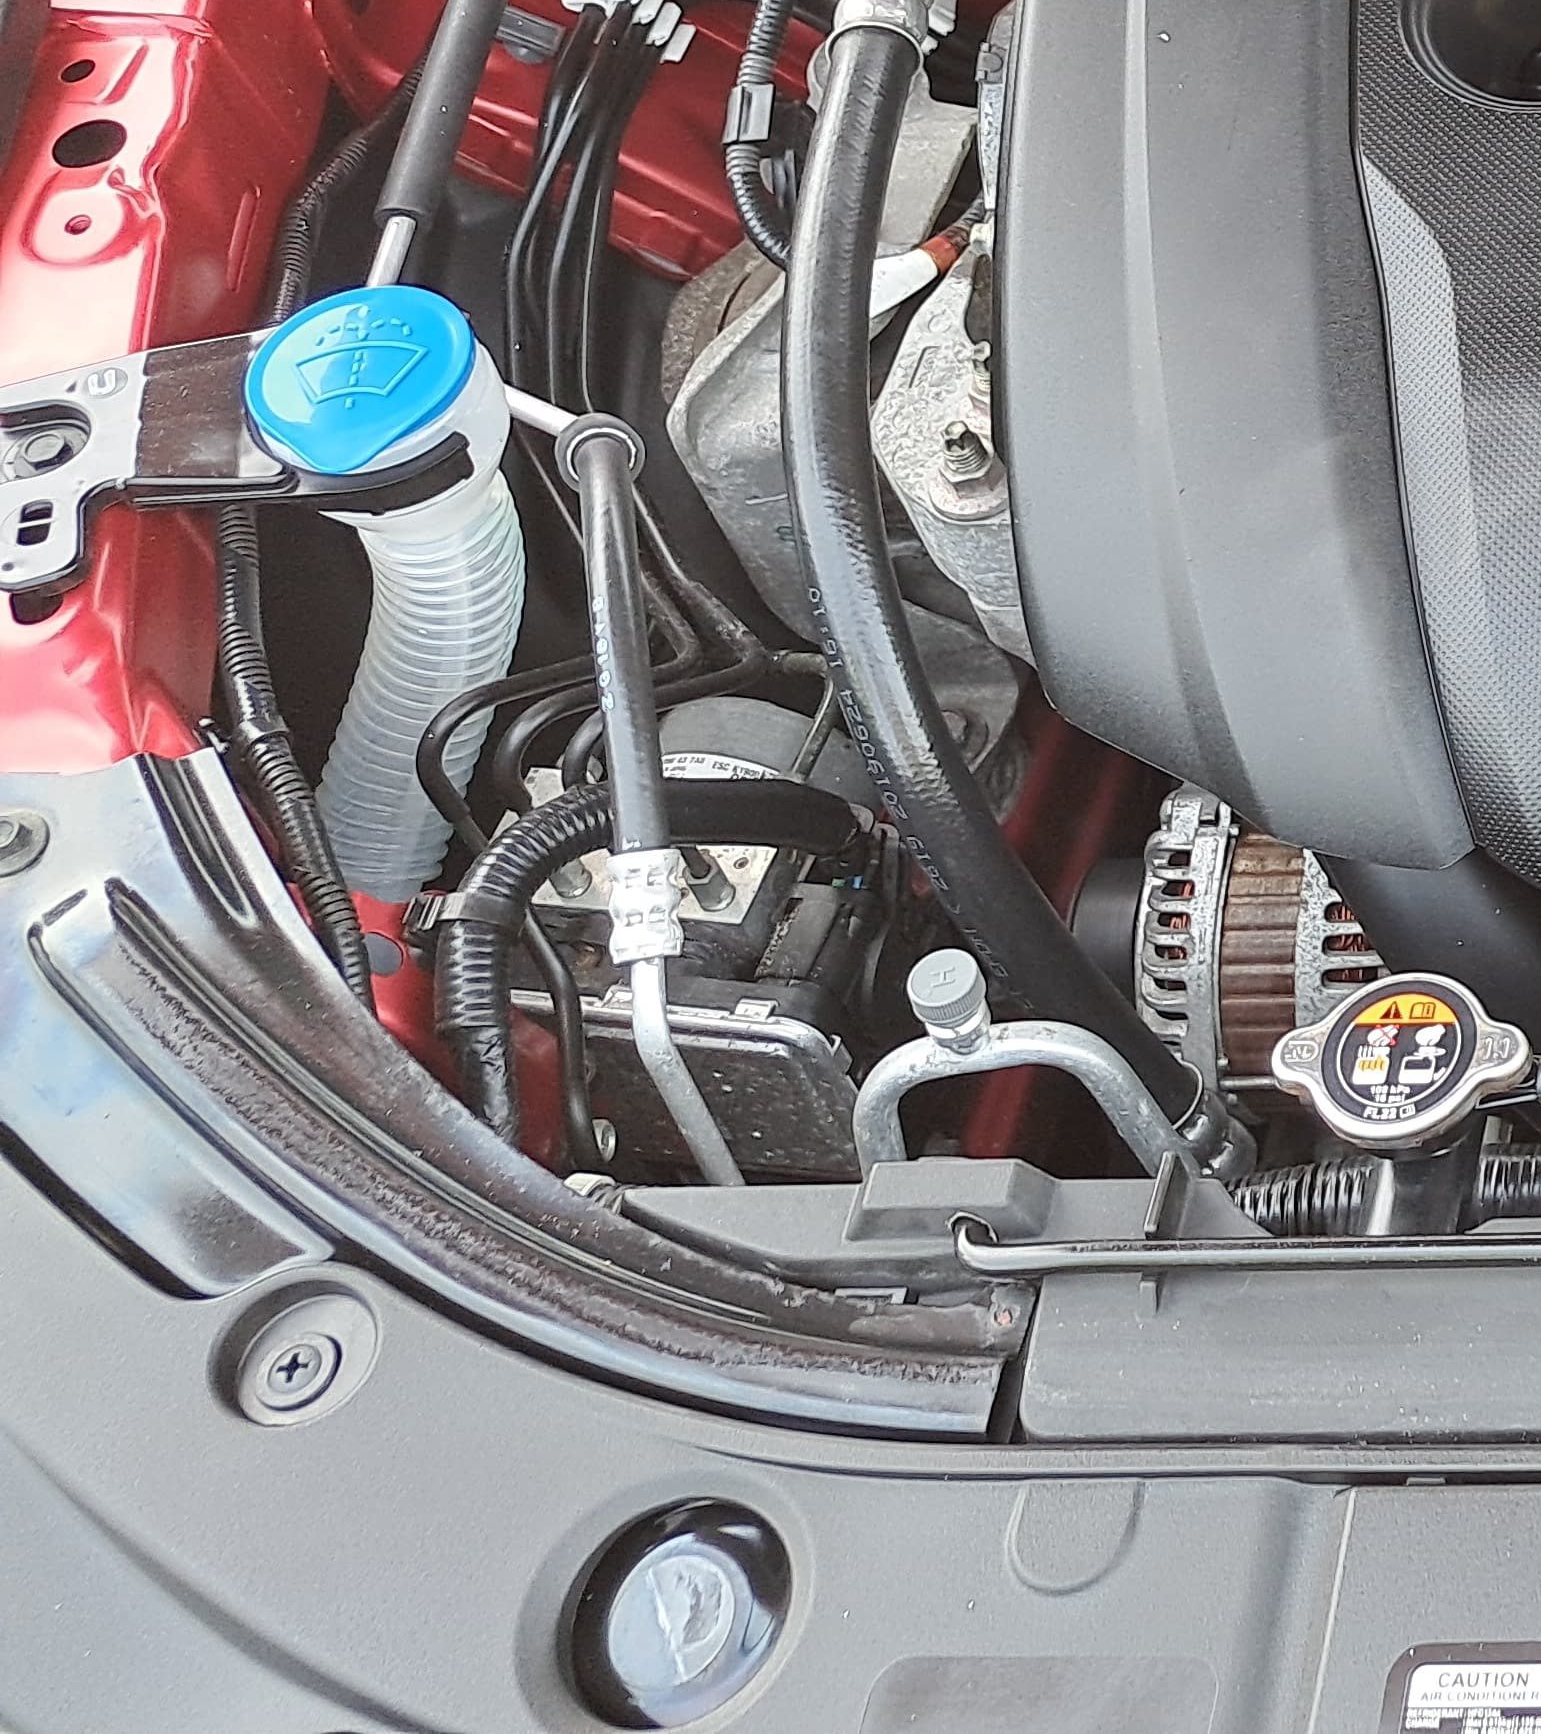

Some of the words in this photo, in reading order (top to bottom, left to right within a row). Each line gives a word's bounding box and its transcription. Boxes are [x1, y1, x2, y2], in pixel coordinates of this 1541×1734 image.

[1438, 1672, 1530, 1688] CAUTION
[1420, 1691, 1443, 1702] AIR
[1447, 1691, 1541, 1702] CONDITIONER
